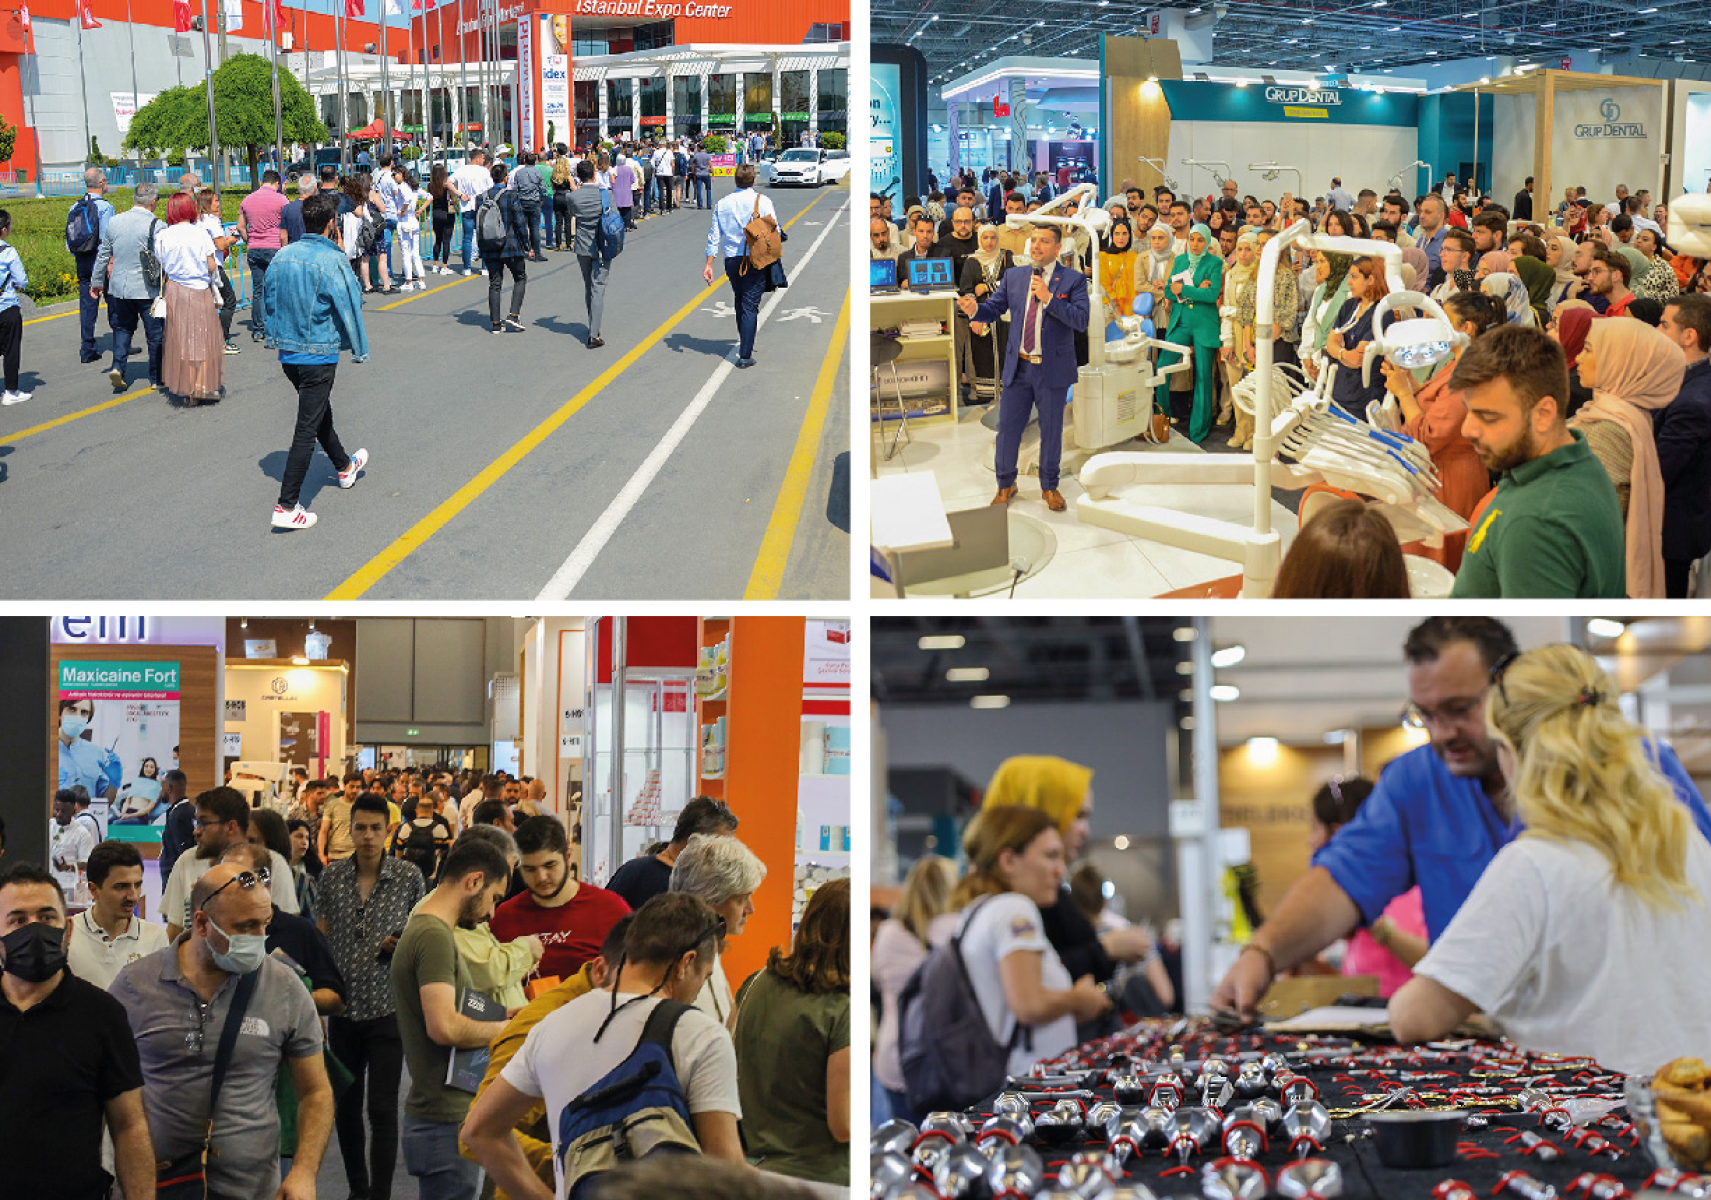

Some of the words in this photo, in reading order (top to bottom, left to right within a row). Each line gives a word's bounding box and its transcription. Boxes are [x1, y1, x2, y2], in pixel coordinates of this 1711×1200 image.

[644, 0, 682, 19] Expo
[684, 1, 733, 18] Center
[543, 68, 566, 78] idex
[1265, 86, 1298, 102] GRUP
[1298, 87, 1341, 104] DENTAL
[1574, 123, 1603, 138] GRUP
[1603, 123, 1646, 137] DENTAL
[62, 667, 142, 683] Maxicaine
[144, 668, 177, 683] Fort
